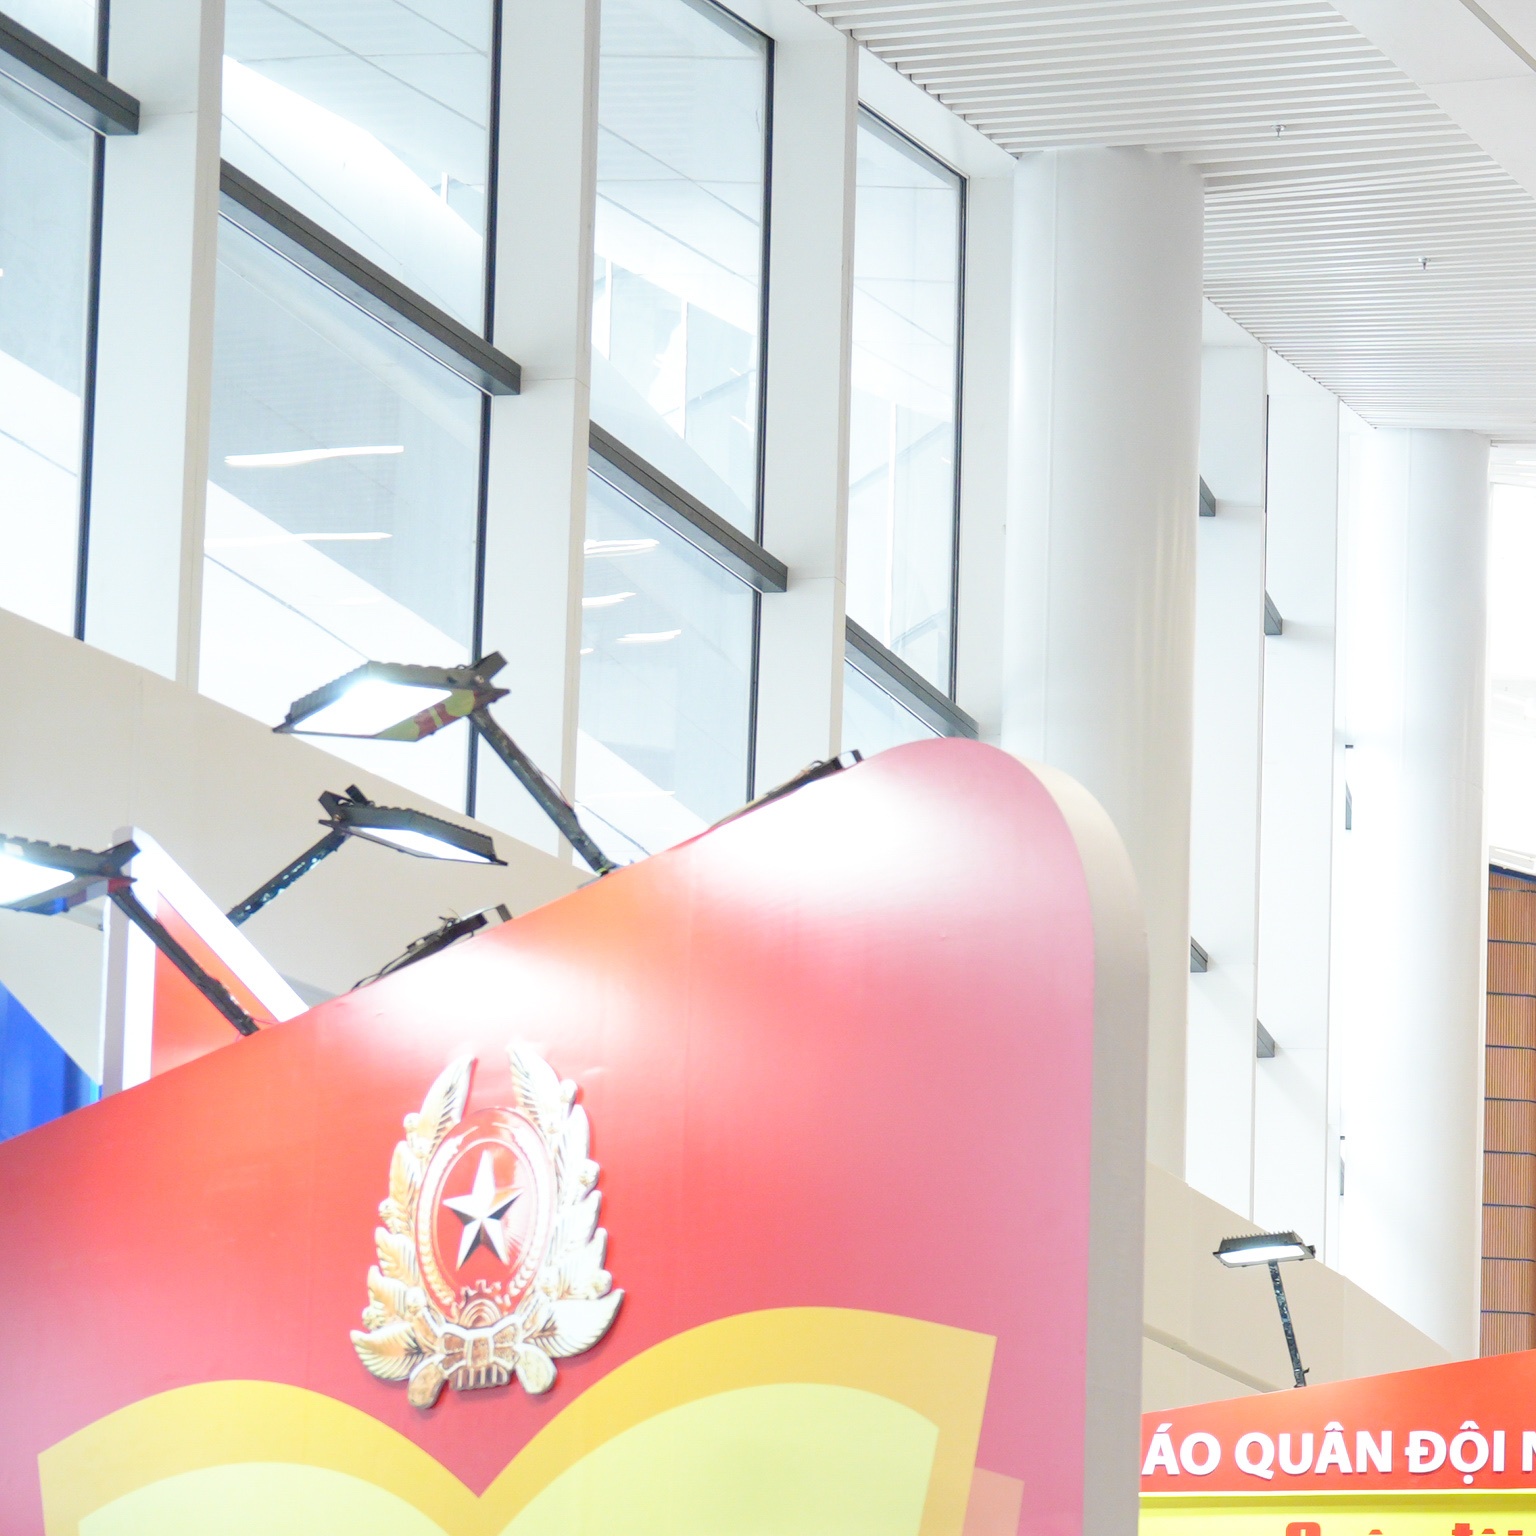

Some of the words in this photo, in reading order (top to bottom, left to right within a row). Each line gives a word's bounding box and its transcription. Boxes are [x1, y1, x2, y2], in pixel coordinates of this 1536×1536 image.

[1142, 1423, 1222, 1475] ÁO
[1235, 1421, 1392, 1479] QUÂN
[1405, 1421, 1505, 1484] ĐỘI
